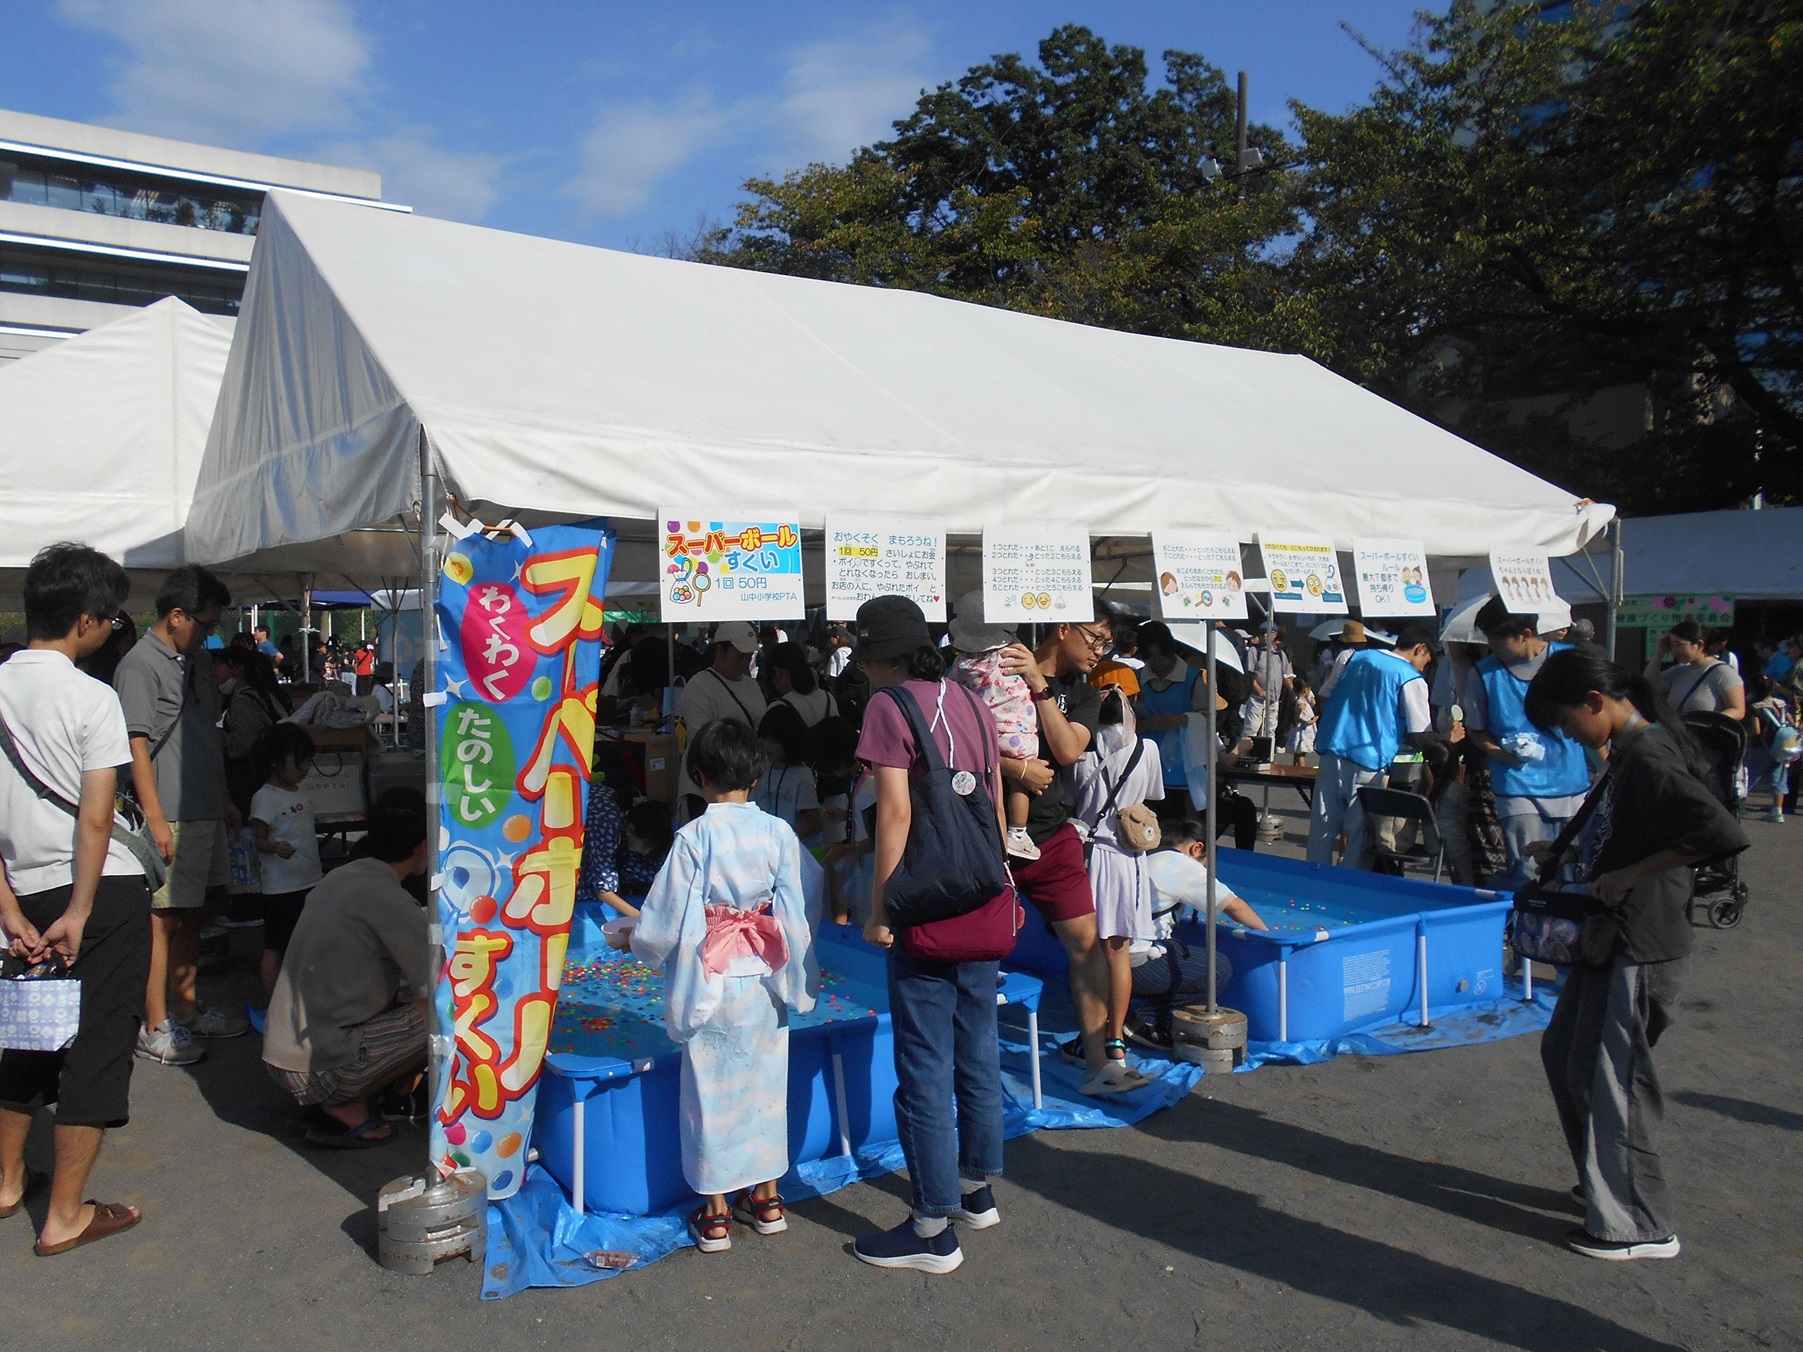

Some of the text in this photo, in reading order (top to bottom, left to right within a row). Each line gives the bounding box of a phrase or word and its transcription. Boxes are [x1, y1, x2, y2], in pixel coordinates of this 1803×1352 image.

[666, 524, 799, 558] スーパーボール
[834, 532, 937, 547] おやくそく まもろうね！
[839, 547, 936, 560] 1回 50円 さいしょにお金
[1360, 552, 1419, 561] スーパーボールすくい
[723, 550, 780, 573] すくい
[839, 569, 936, 580] とれなくなったら おしまい。
[715, 577, 767, 589] 1回 50円
[1370, 584, 1394, 593] 持ち帰り
[740, 592, 797, 601] 山中小学校PTA
[478, 586, 519, 700] わくわく
[457, 707, 496, 821] たのしい
[438, 928, 514, 1127] すくい
